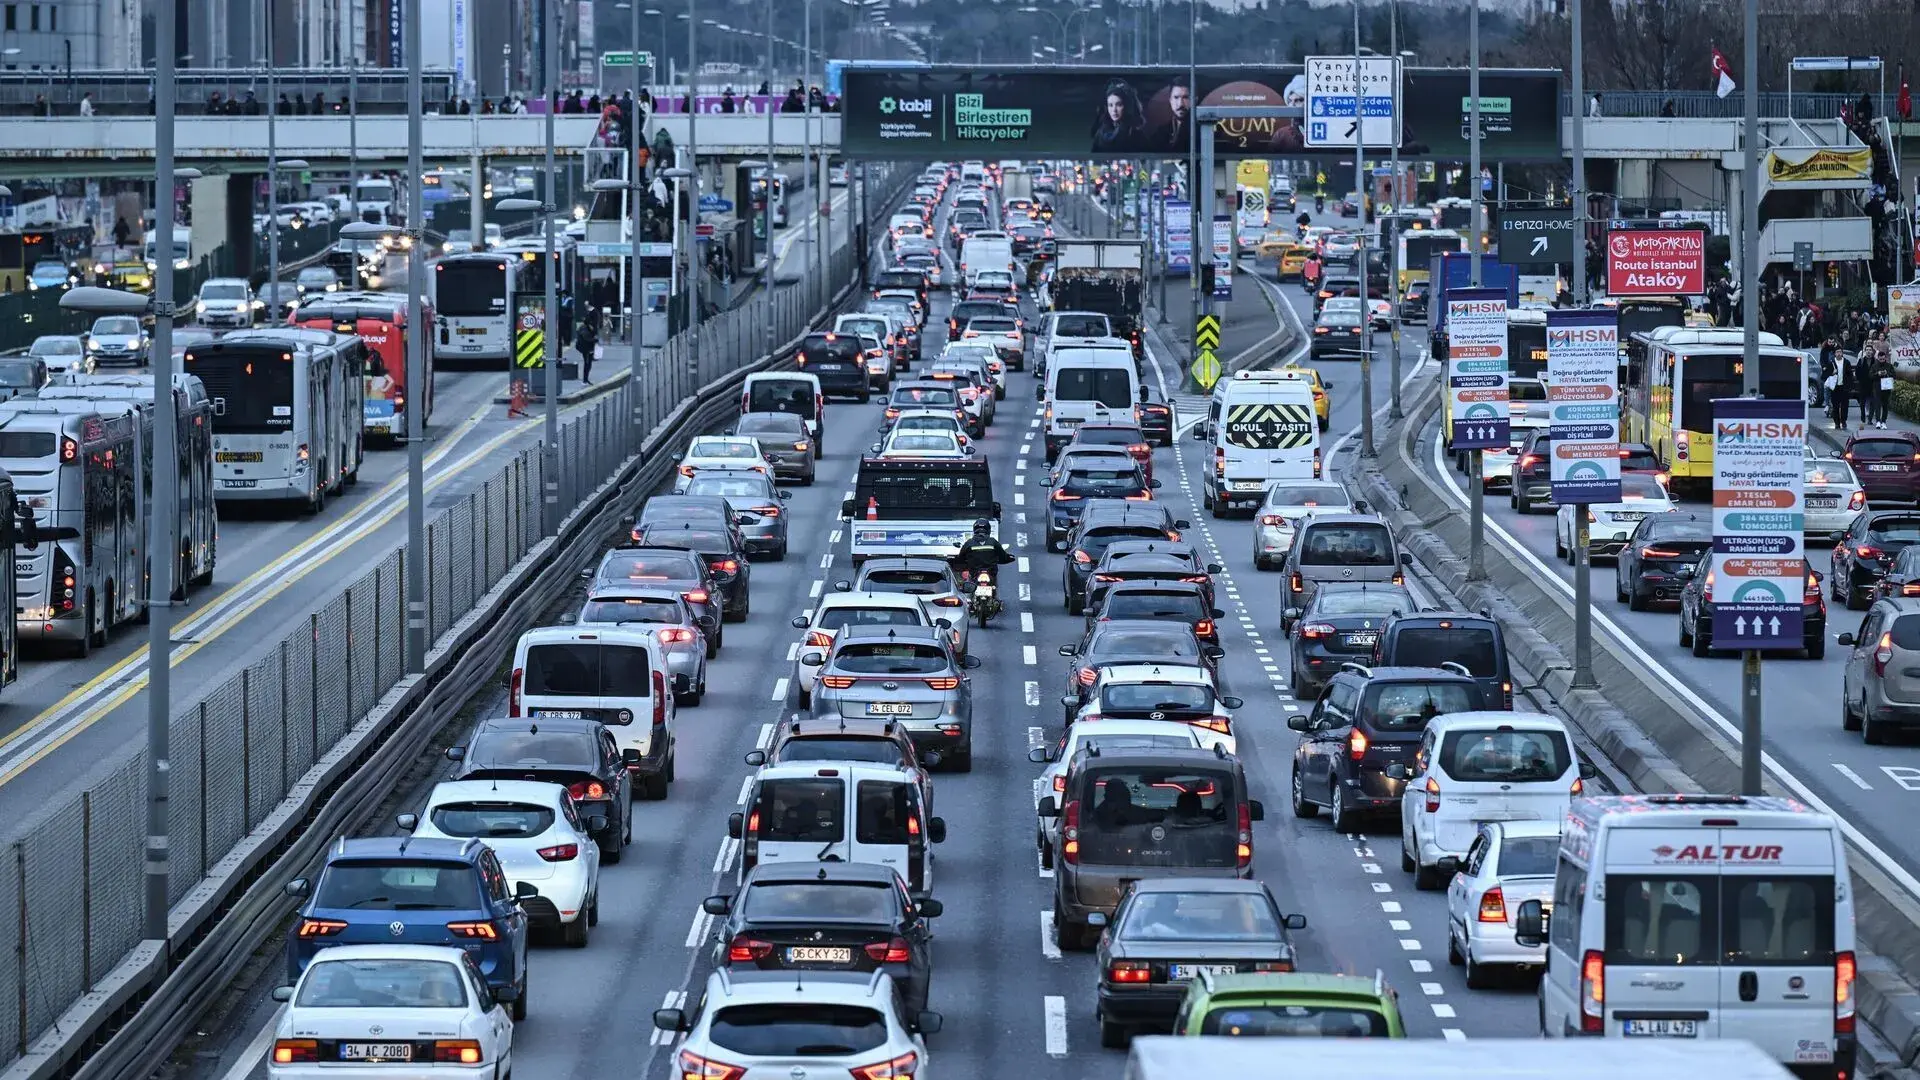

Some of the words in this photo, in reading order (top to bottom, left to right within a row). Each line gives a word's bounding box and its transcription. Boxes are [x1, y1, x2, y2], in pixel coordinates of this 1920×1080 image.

[1314, 62, 1368, 72] Yanyl
[900, 99, 932, 112] tabii
[958, 97, 981, 108] Bizi
[958, 111, 1028, 124] Birleştiren
[958, 127, 1025, 141] Hikayeler
[1314, 125, 1325, 138] H
[1239, 137, 1247, 147] 2
[1514, 221, 1542, 230] enza
[1544, 220, 1573, 229] HOME
[1615, 261, 1648, 270] Route
[1651, 258, 1697, 269] İstanbul
[1626, 272, 1686, 289] Ataköy
[1469, 303, 1505, 312] HSM
[1571, 330, 1615, 342] HSM
[1232, 424, 1262, 432] OKUL
[1274, 424, 1308, 433] TAŞITI
[1746, 424, 1802, 438] HSM
[1676, 845, 1783, 859] ALTUR
[793, 948, 805, 958] 06
[808, 949, 829, 958] CKY
[833, 950, 849, 959] 321
[1177, 966, 1189, 976] 34
[1631, 1021, 1643, 1033] 34
[1673, 1021, 1693, 1033] 479
[347, 1046, 359, 1057] 34
[366, 1046, 377, 1057] AC
[383, 1046, 409, 1056] 2080
